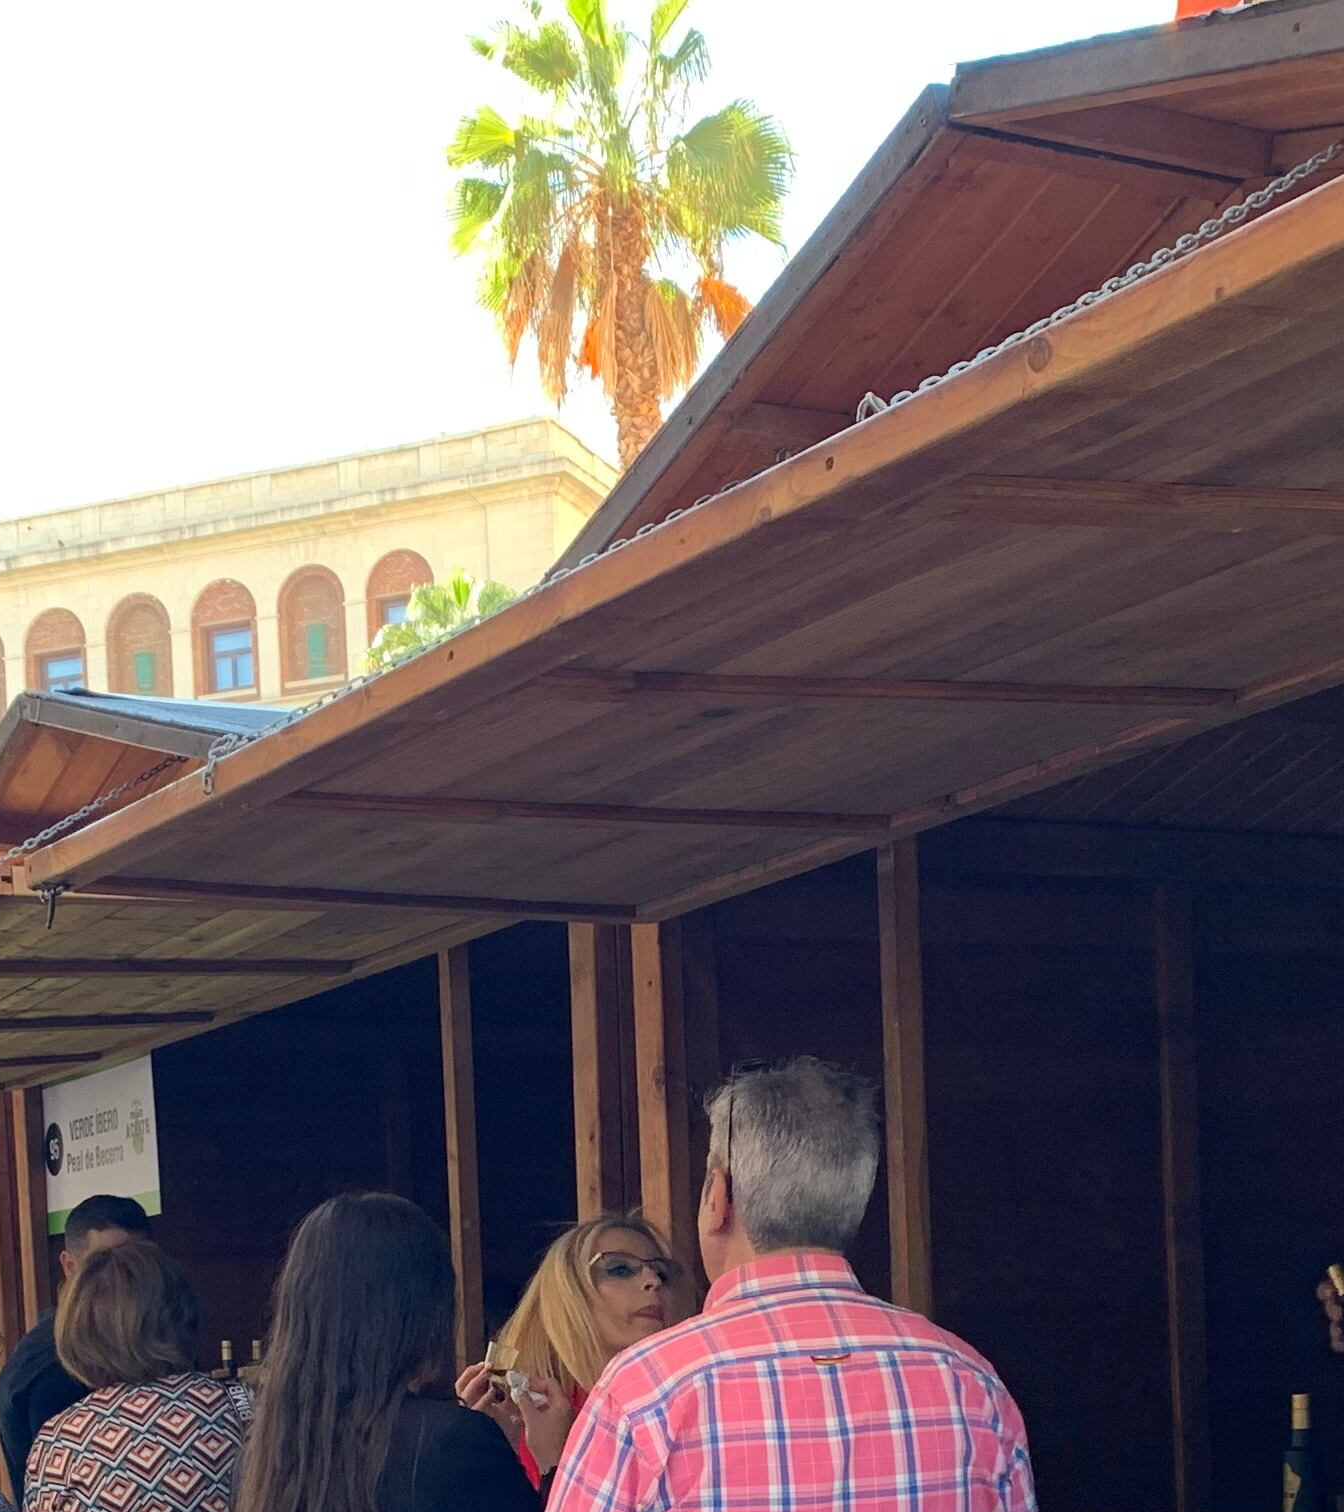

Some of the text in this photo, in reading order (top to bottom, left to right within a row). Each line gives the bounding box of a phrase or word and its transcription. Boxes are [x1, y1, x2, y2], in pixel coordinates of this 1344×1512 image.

[69, 1114, 95, 1141] VERDE
[49, 1138, 60, 1161] 95
[67, 1144, 124, 1174] Peal de Becerra
